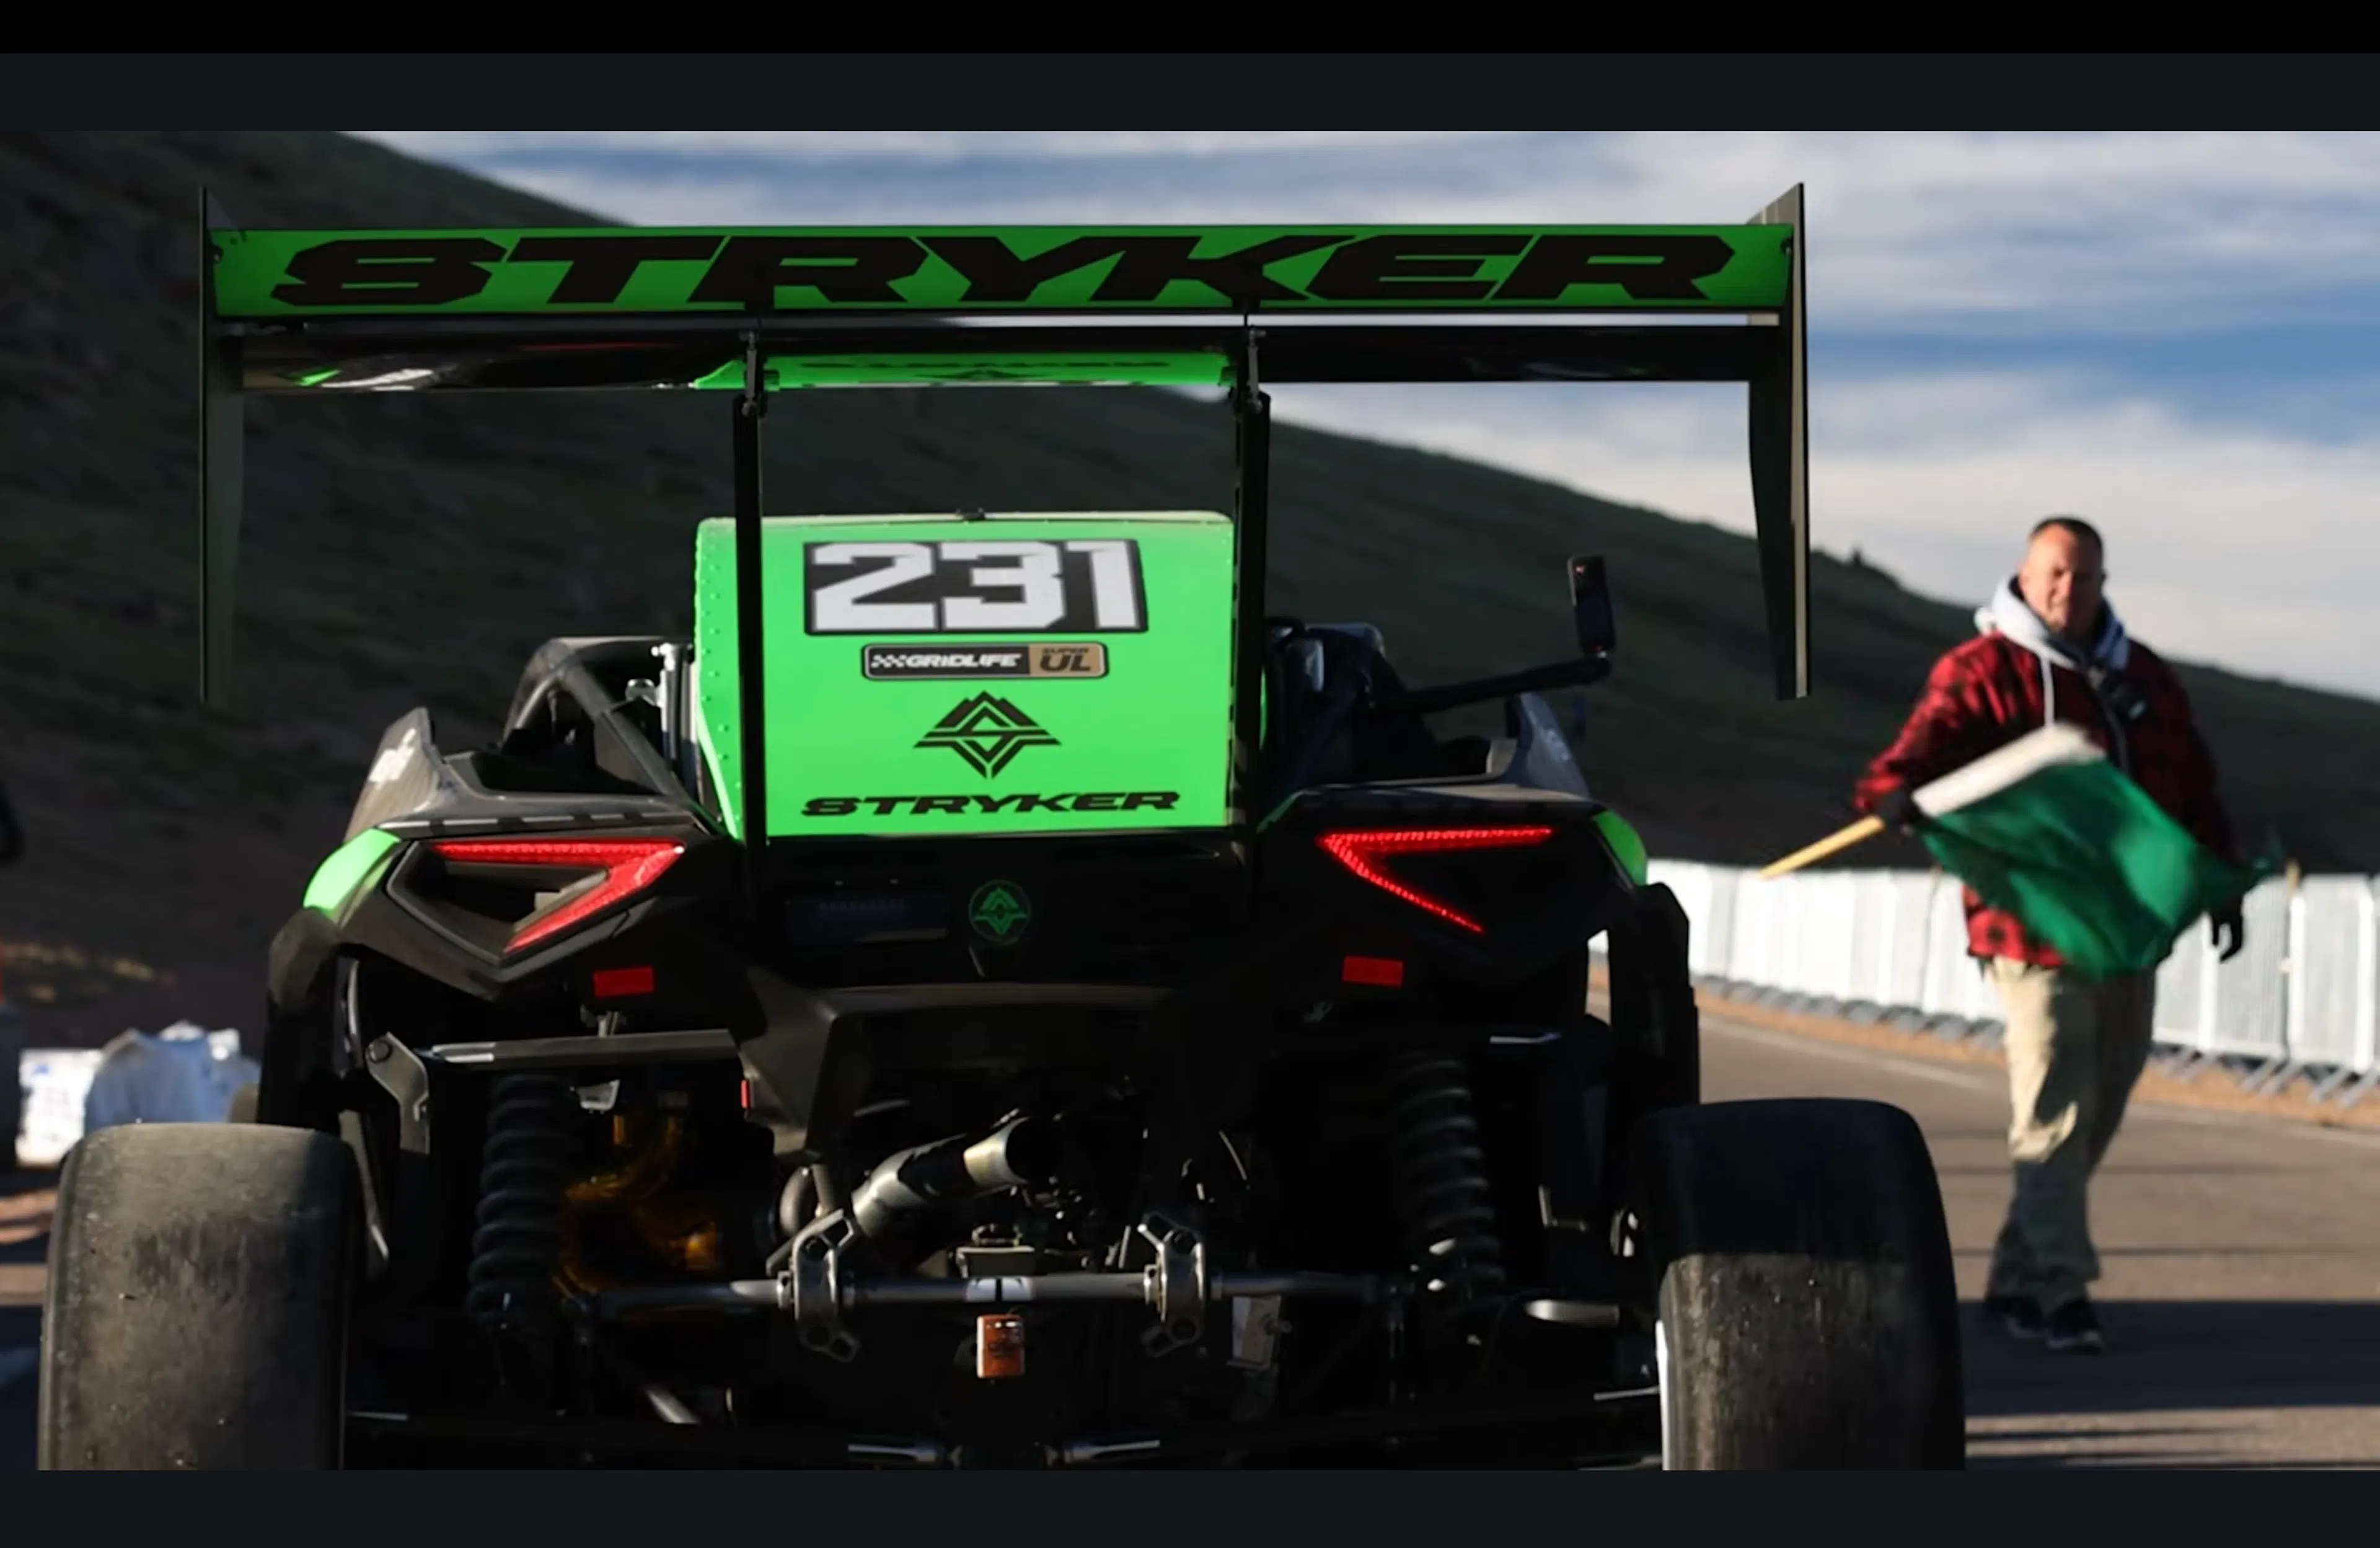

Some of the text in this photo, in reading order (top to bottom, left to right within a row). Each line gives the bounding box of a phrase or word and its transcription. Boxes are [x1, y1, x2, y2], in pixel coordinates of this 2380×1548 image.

[271, 235, 1734, 304] STRYKER
[813, 541, 1139, 630] 231
[906, 653, 1022, 668] GRIDLIFE
[1039, 654, 1091, 672] UL
[801, 792, 1180, 816] STRYKER
